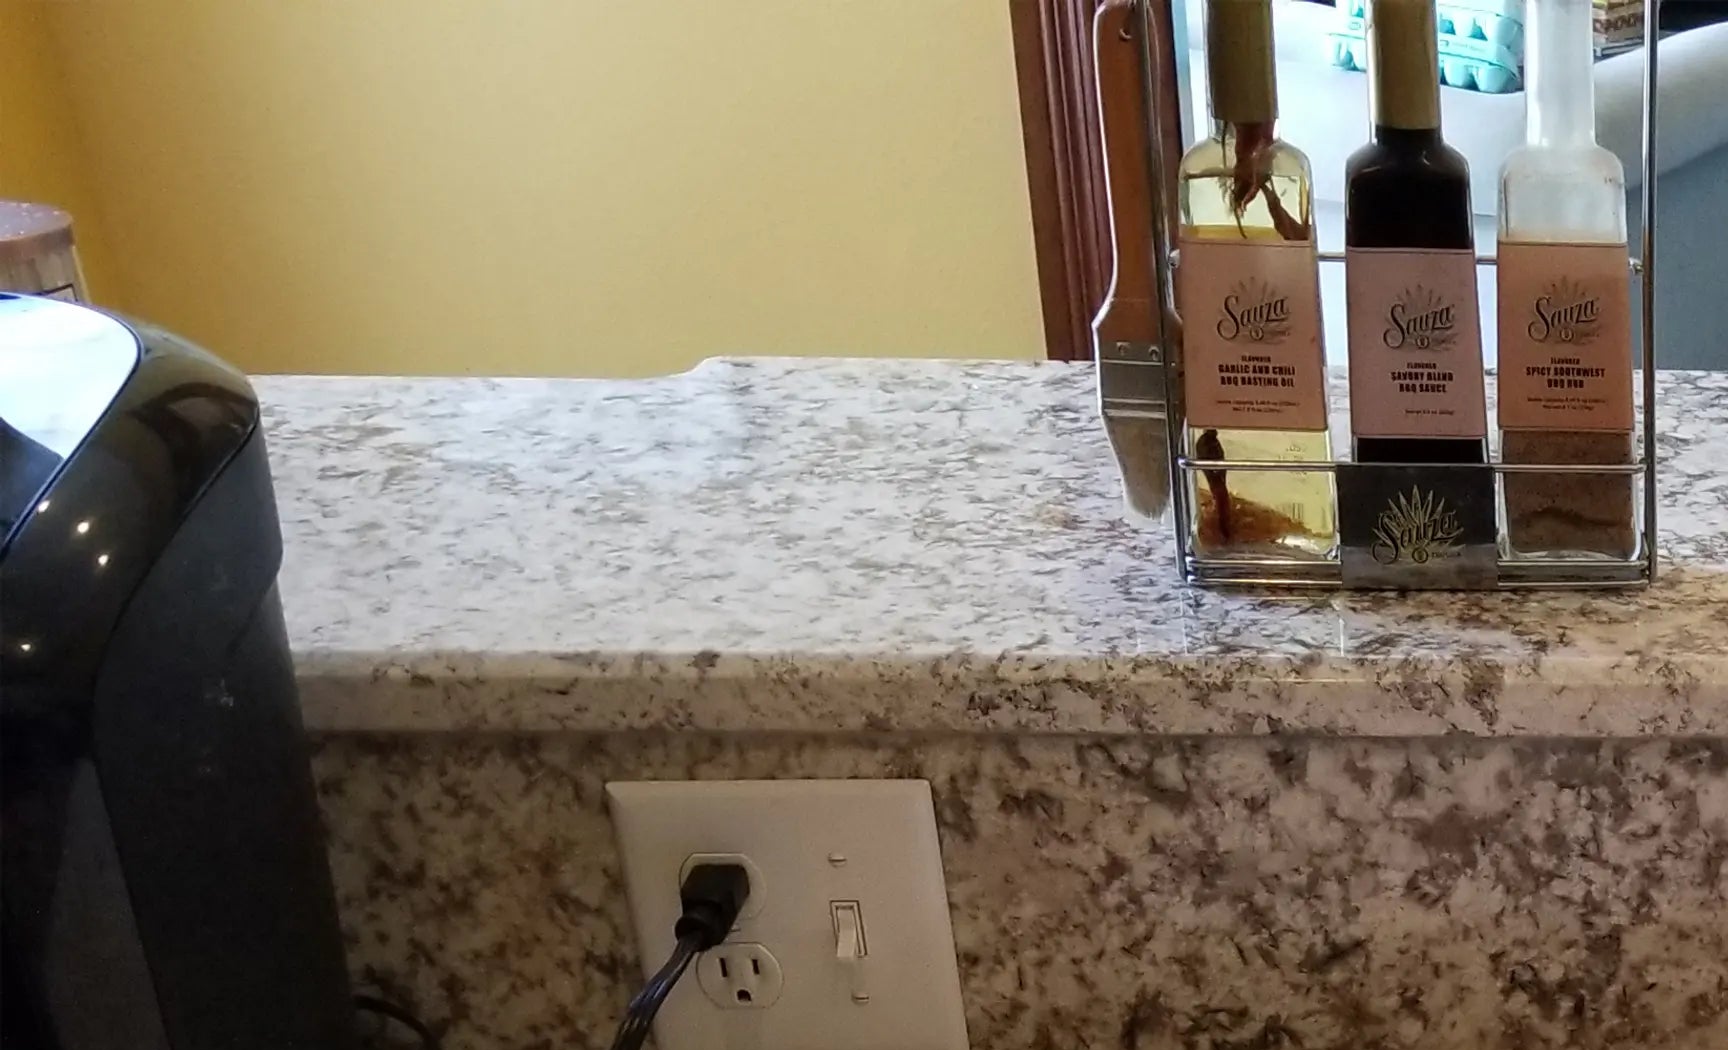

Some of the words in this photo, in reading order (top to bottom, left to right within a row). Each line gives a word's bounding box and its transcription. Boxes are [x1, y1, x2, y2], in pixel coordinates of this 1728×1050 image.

[1217, 295, 1288, 340] Sauza
[1528, 297, 1598, 342] Sauza
[1383, 303, 1455, 349] Sauza
[1218, 364, 1250, 374] GARLIC
[1252, 365, 1270, 375] AND
[1272, 366, 1295, 376] CHILI
[1391, 371, 1424, 381] SAVORY
[1526, 366, 1551, 376] SPICY
[1554, 367, 1605, 377] SOUTHWEST
[1220, 376, 1239, 386] BBQ
[1241, 377, 1278, 387] BASTING
[1280, 378, 1295, 388] OIL
[1399, 383, 1417, 393] BBQ
[1419, 383, 1447, 393] SAUCE
[1371, 510, 1464, 565] Sauza
